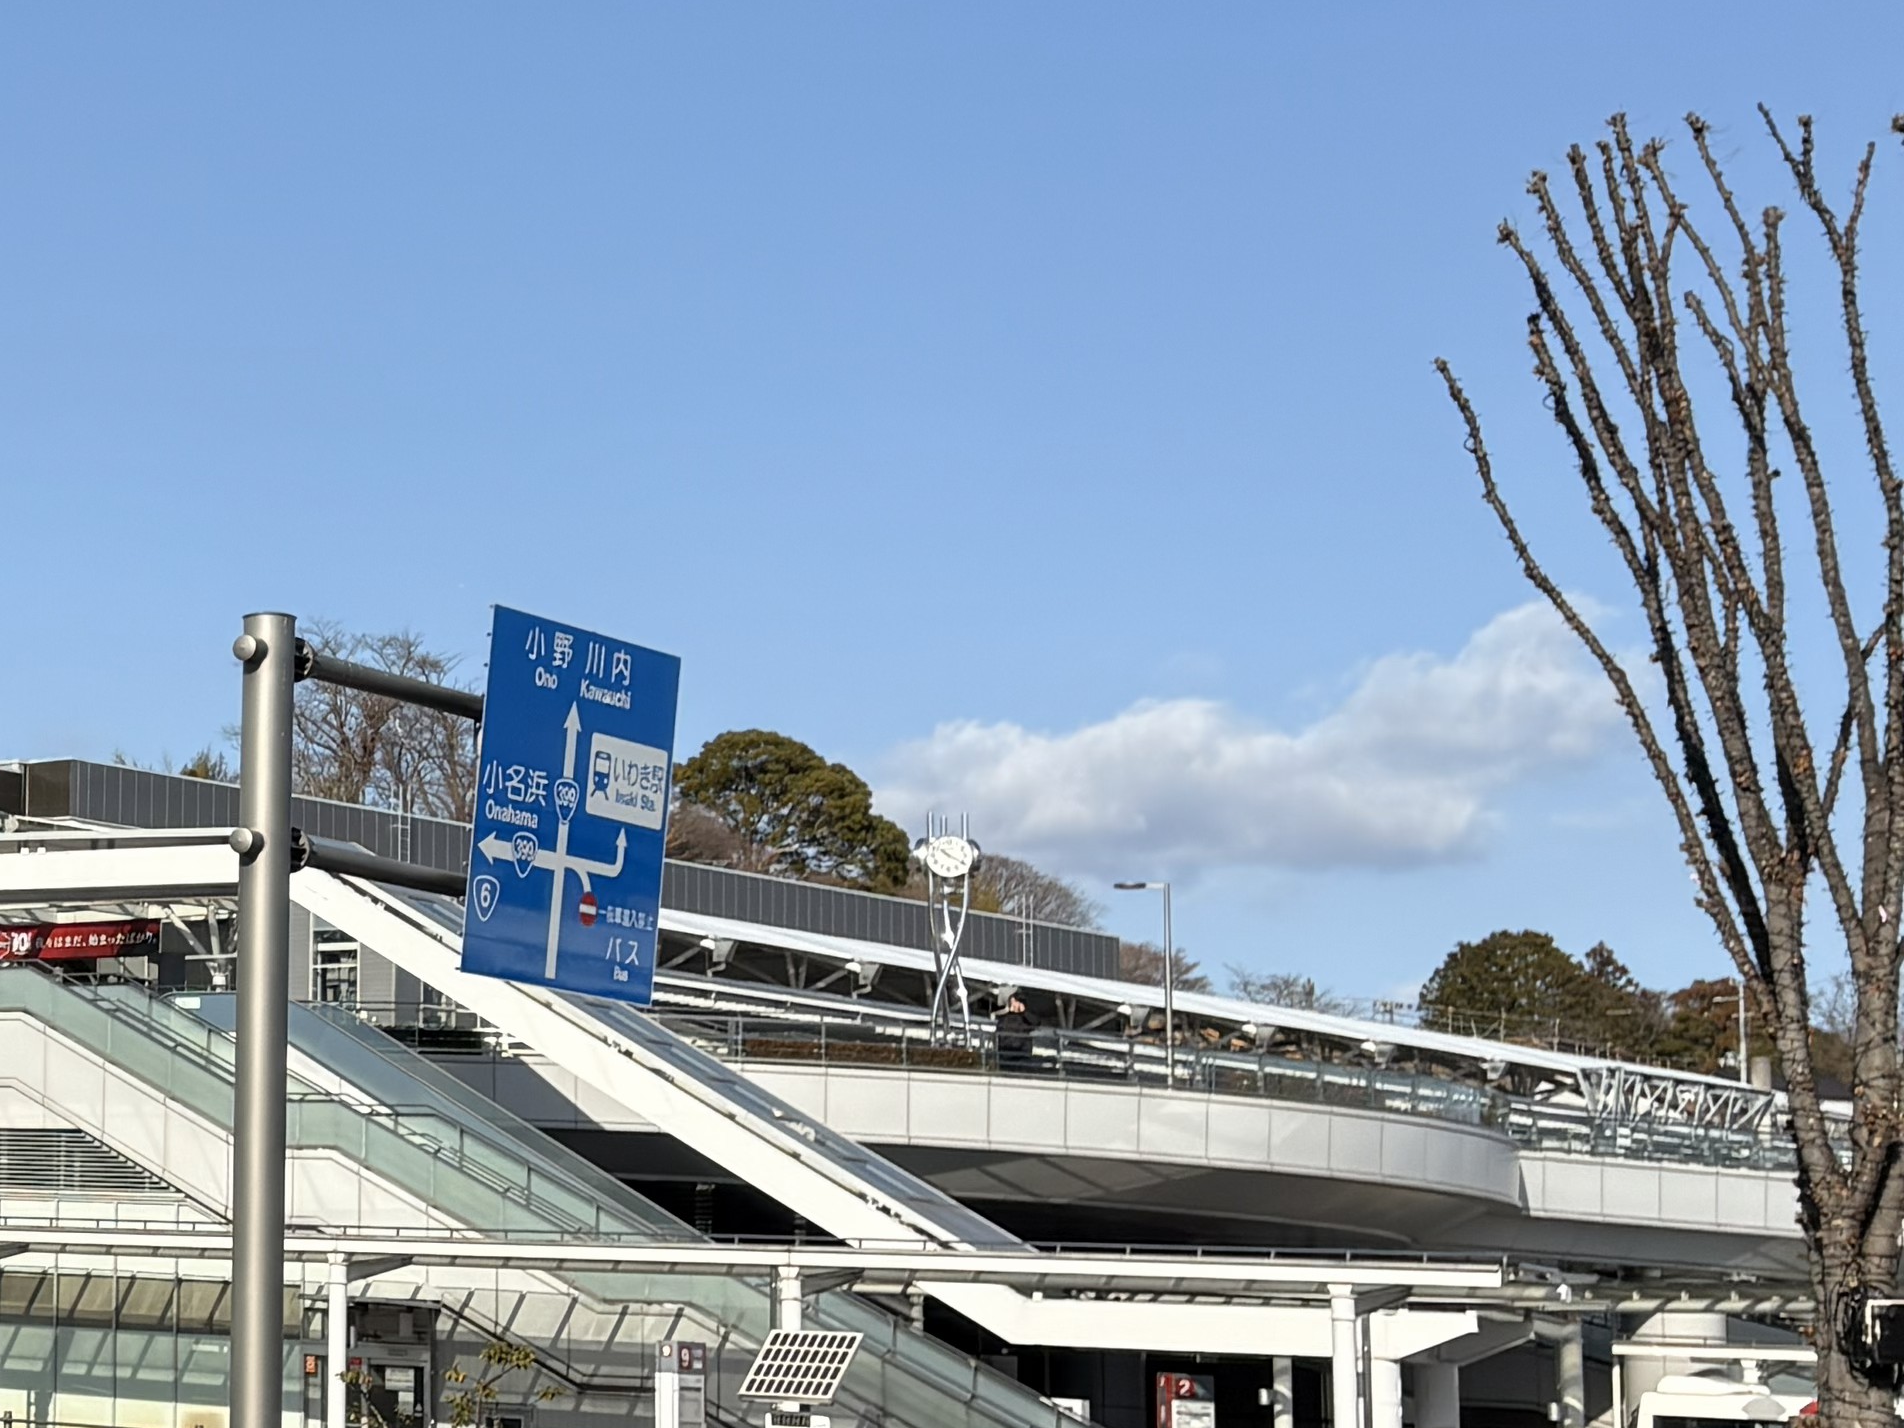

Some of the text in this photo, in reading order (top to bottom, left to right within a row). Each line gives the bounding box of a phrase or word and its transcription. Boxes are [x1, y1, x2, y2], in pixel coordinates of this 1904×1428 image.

[525, 626, 631, 686] 小野 川内
[535, 667, 631, 709] Ono Kawauchi
[483, 759, 549, 807] 小名浜
[613, 756, 664, 794] いわき駅
[485, 799, 539, 829] Onahama
[516, 838, 534, 861] 399
[481, 882, 491, 908] 6
[605, 936, 639, 966] バス
[681, 1348, 690, 1367] 9
[1178, 1378, 1191, 1397] 2
